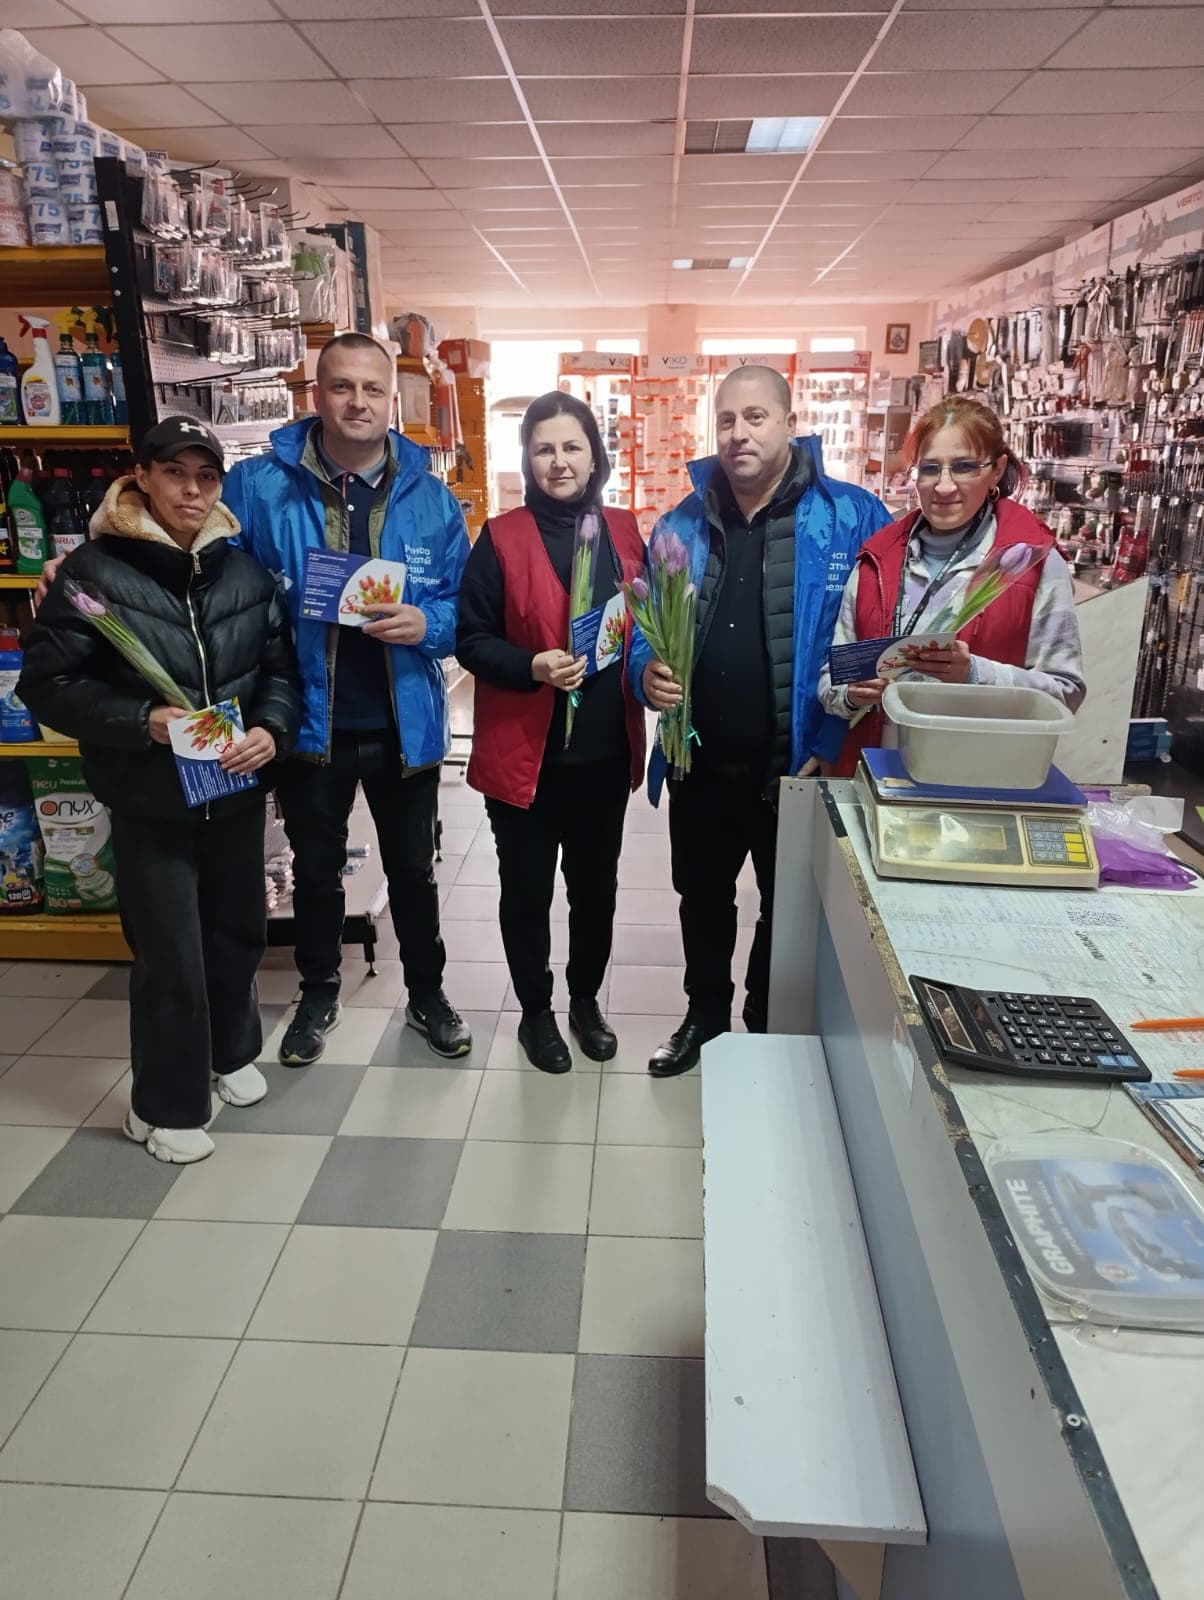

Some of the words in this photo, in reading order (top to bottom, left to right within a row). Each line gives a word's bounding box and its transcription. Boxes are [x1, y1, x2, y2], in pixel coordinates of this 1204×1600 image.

[31, 166, 57, 183] 75
[1177, 190, 1203, 208] VERTO
[36, 203, 60, 217] 75
[8, 892, 22, 900] 120
[1006, 1178, 1075, 1275] GRAPHITE
